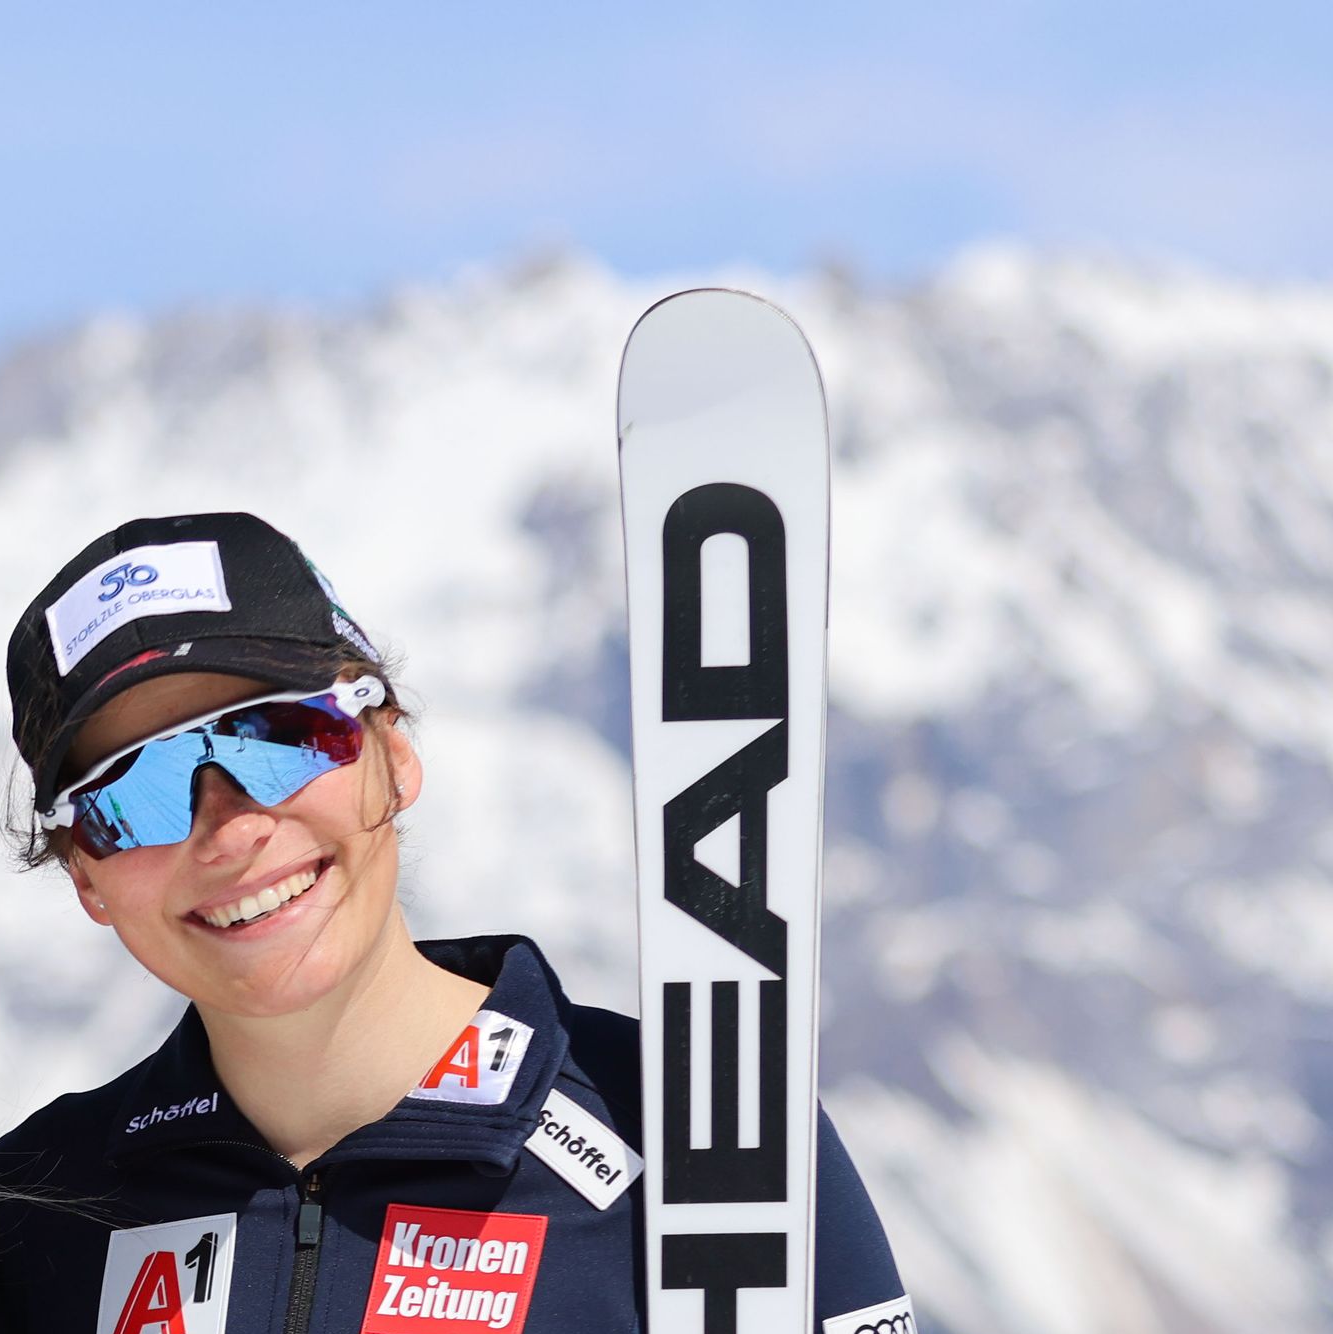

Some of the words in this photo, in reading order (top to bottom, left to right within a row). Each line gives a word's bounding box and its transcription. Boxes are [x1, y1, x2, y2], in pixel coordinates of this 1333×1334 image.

[66, 601, 124, 656] STOELZLE
[128, 588, 216, 604] OBERGLAS
[419, 1025, 516, 1089] A1
[388, 1222, 528, 1275] Kronen
[377, 1275, 518, 1329] Zeitung
